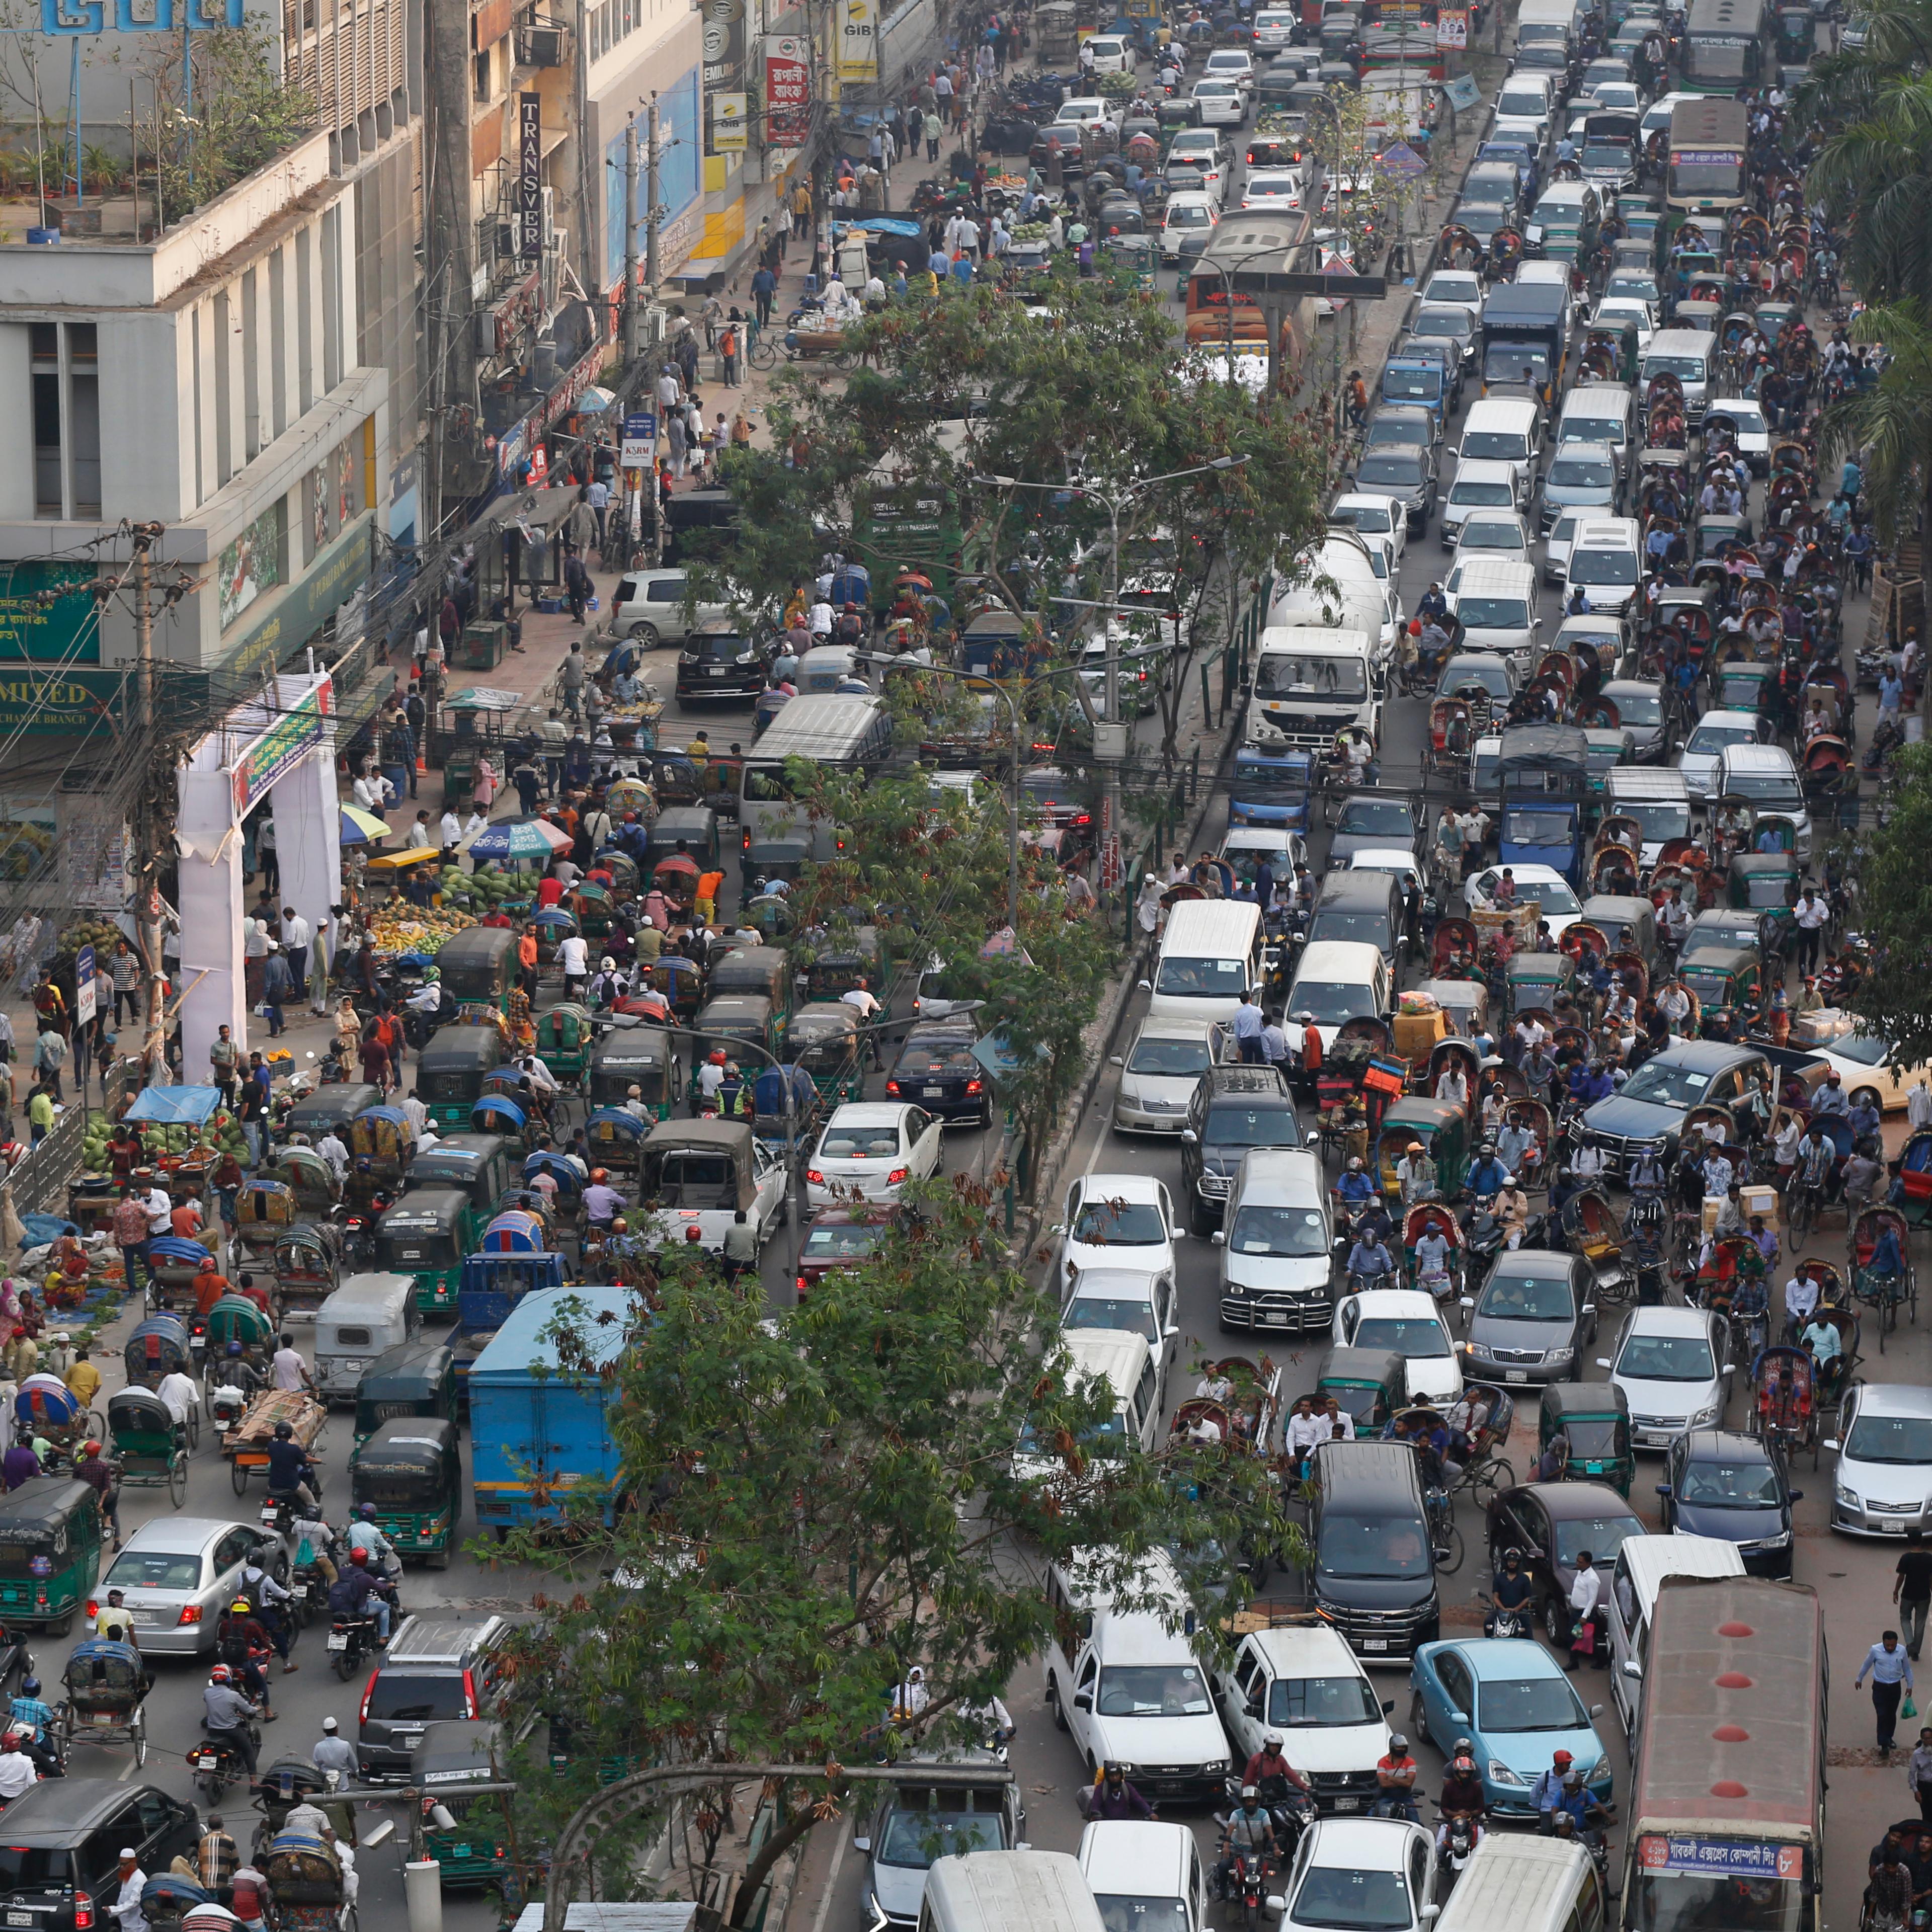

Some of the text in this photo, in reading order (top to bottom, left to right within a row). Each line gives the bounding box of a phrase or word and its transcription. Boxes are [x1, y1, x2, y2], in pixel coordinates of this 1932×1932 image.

[522, 103, 539, 244] TRANSVER
[625, 446, 650, 455] KSRM
[43, 713, 87, 725] BRANCH
[511, 825, 534, 835] ঢাকা
[1670, 1841, 1776, 1866] গাবতলী এক্সপ্রেস কোম্পানী লিঃ
[1779, 1855, 1793, 1873] ৮
